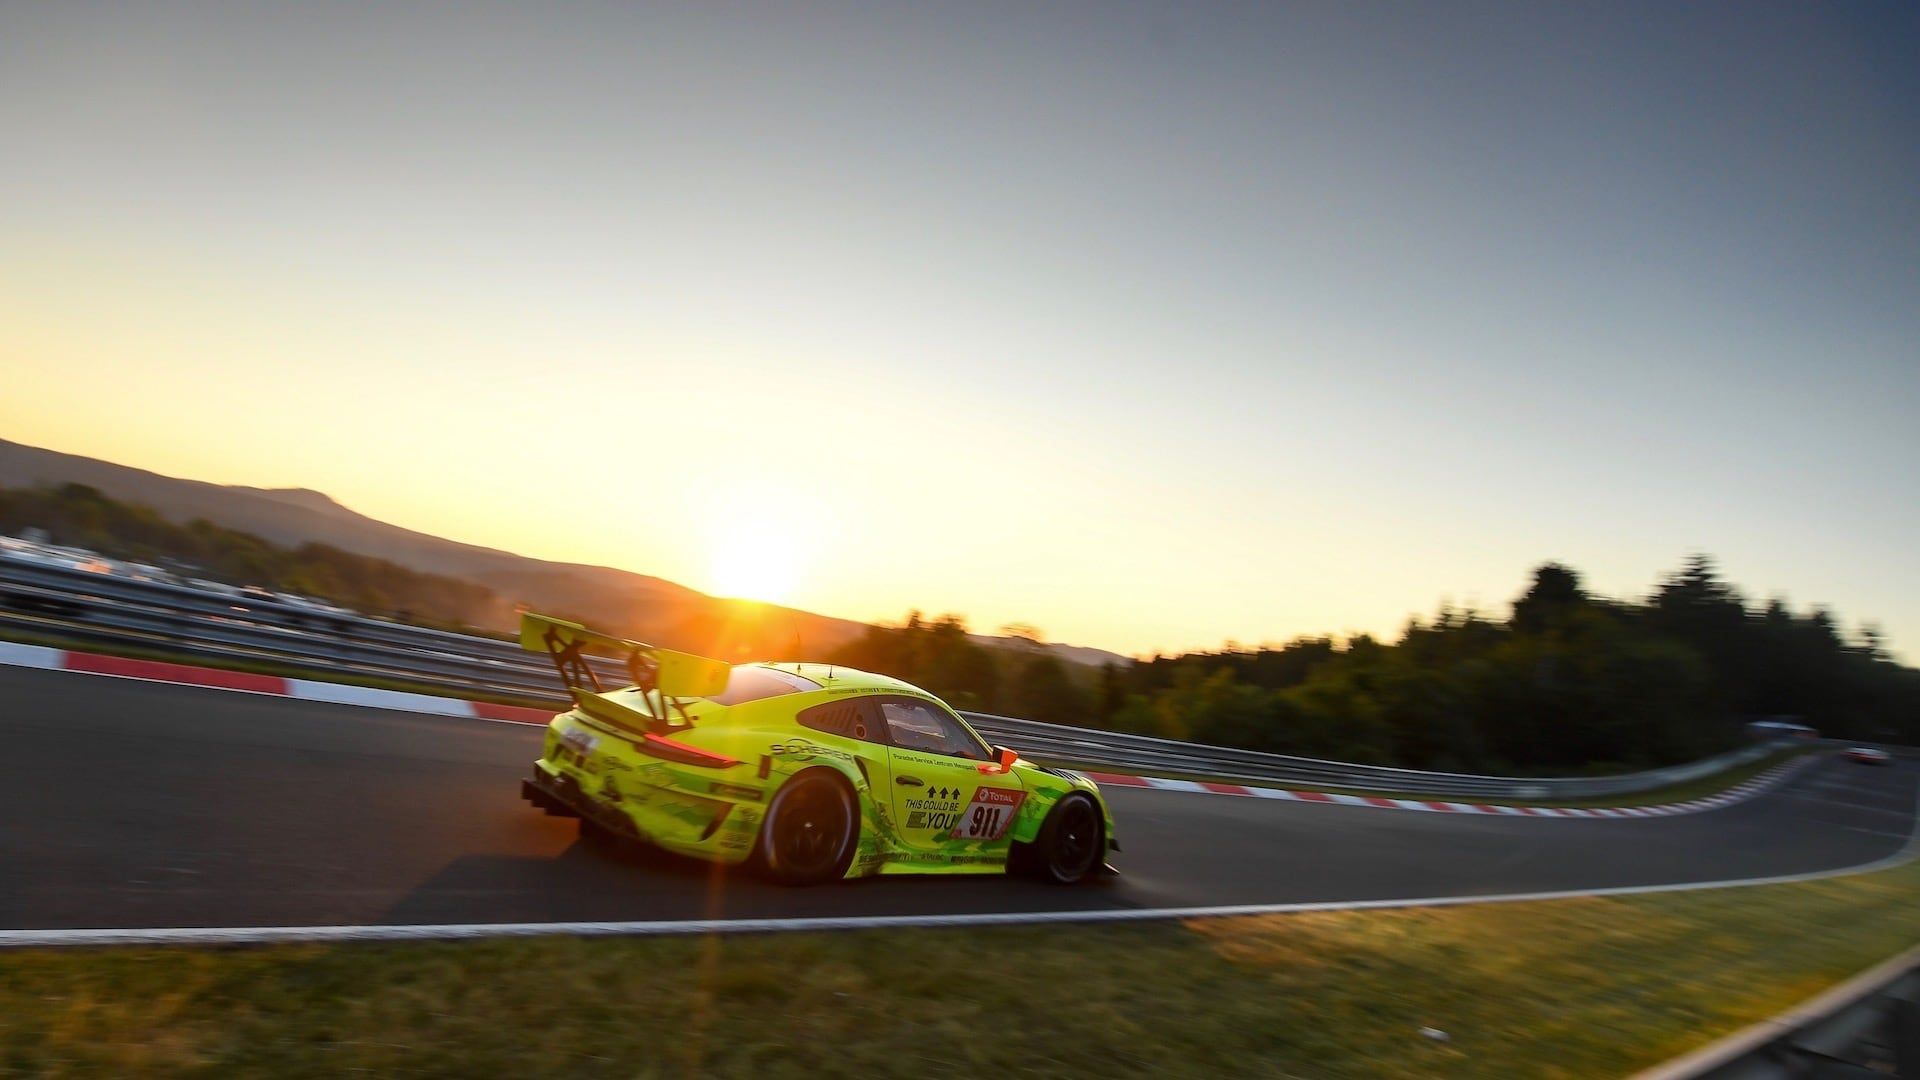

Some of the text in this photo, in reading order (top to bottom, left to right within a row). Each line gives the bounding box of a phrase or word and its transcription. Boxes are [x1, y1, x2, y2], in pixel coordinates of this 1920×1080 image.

[989, 791, 1013, 803] TOTAL
[905, 799, 960, 812] THIS COULD BE
[969, 806, 1001, 838] 911
